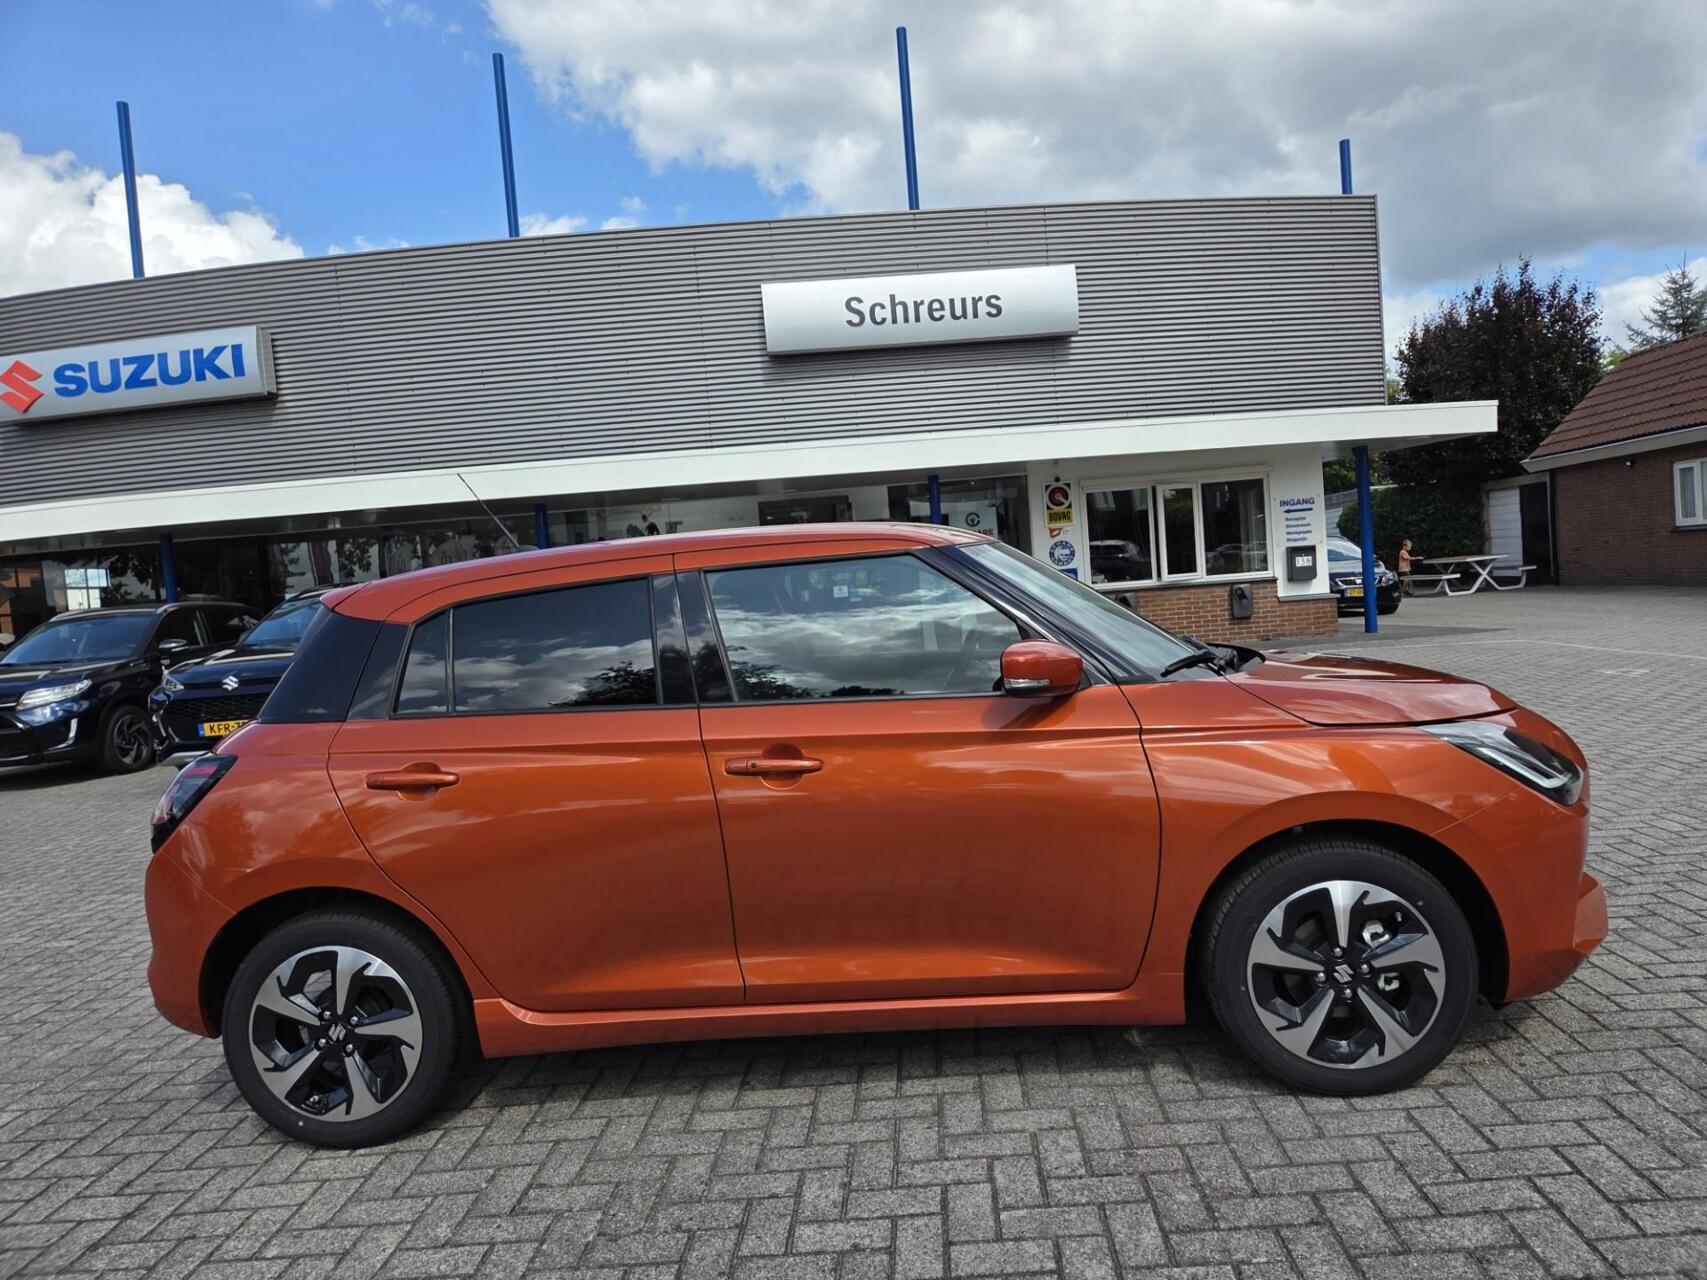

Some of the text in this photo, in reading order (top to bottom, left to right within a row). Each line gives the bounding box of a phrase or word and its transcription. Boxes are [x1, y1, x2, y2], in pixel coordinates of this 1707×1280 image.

[844, 292, 1003, 328] Schreurs
[53, 343, 246, 398] SUZUKI
[1280, 497, 1315, 507] INGANG
[1048, 511, 1071, 522] BOVAG
[209, 721, 248, 734] KFR-7
